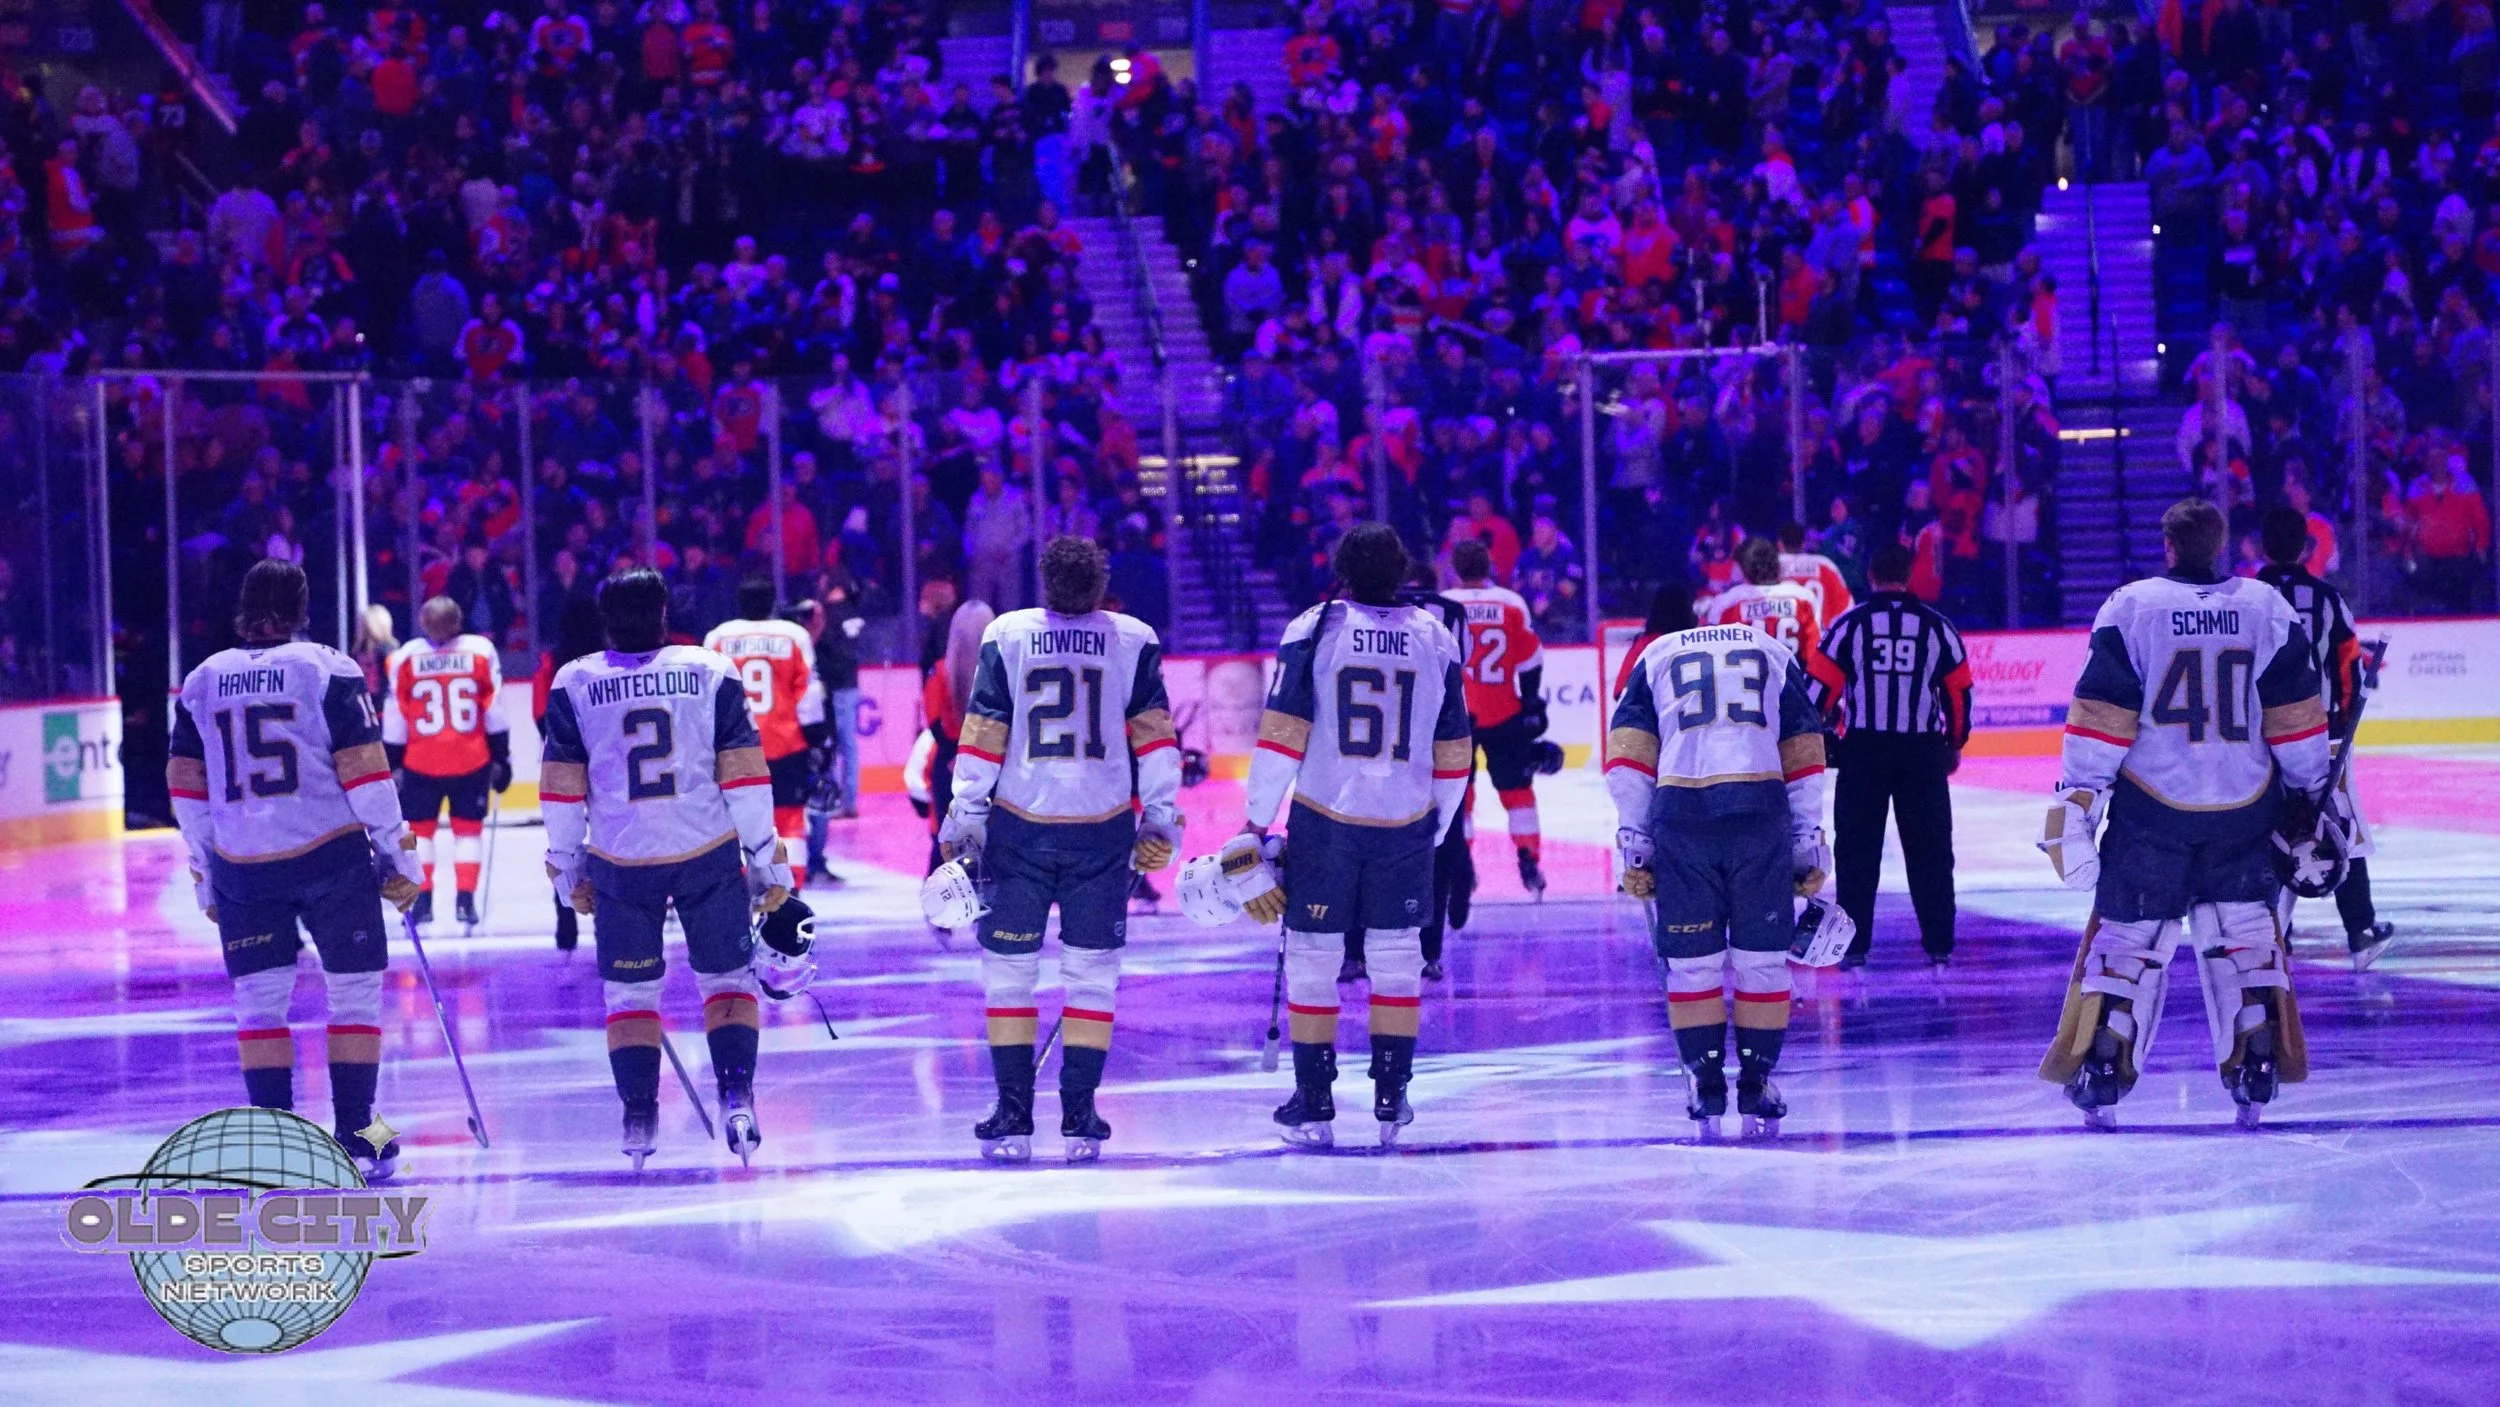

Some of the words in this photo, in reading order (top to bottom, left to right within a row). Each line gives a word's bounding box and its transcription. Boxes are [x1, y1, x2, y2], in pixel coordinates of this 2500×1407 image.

[1746, 600, 1792, 618] ZEGRAS
[2171, 610, 2239, 636] SCHMID
[1030, 629, 1106, 656] HOWDEN
[1352, 629, 1410, 657] STONE
[1680, 627, 1753, 647] MARNER
[420, 655, 465, 672] ANDRAE
[1464, 628, 1507, 684] 2
[1872, 638, 1916, 673] 39
[219, 669, 285, 697] HANIFIN
[587, 670, 700, 706] WHITECLOUD
[1667, 648, 1770, 732] 93
[2151, 648, 2257, 744] 40
[412, 678, 479, 736] 36
[1024, 664, 1107, 763] 21
[1336, 665, 1416, 762] 61
[45, 731, 123, 778] ent
[214, 703, 299, 803] 15
[622, 706, 678, 802] 2
[227, 933, 273, 951] CCM
[1667, 920, 1713, 933] CCM
